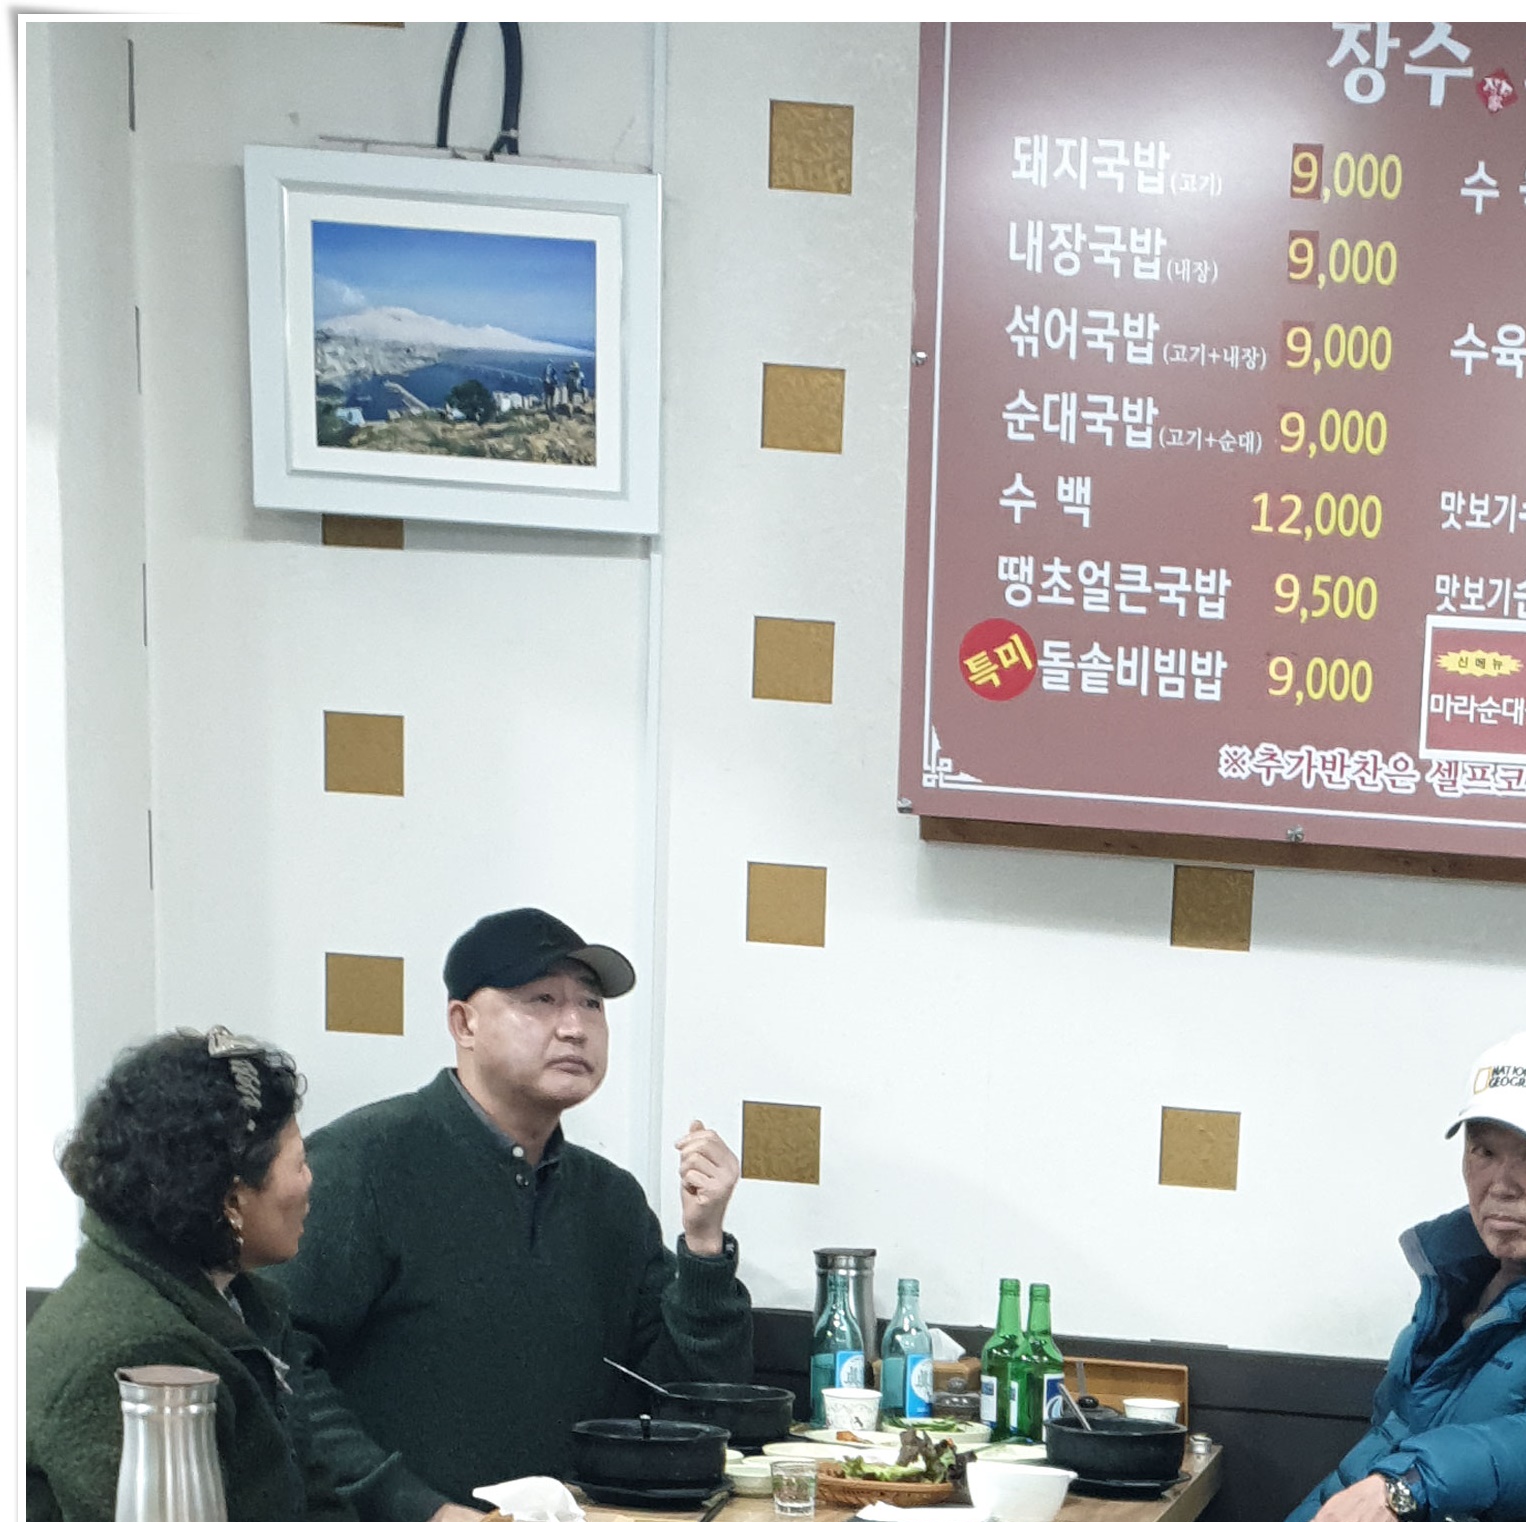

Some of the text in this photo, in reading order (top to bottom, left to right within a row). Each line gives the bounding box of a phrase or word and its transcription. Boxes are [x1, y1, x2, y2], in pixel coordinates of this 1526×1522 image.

[1326, 22, 1474, 106] 장수
[1011, 135, 1170, 195] 돼지국밥
[1292, 150, 1402, 203] 9,000
[1009, 220, 1166, 280] 내장국밥
[1288, 237, 1397, 288] 9,000
[1005, 305, 1159, 365] 섞어국밥
[1286, 324, 1392, 375] 9,000
[1002, 389, 1158, 448] 순대국밥
[1279, 408, 1387, 458] 9,000
[1250, 491, 1382, 542] 12,000
[998, 555, 1377, 624] 땡초얼큰국밥 9,500
[963, 634, 1372, 705] 특미 돌솥비빔밥 9,000
